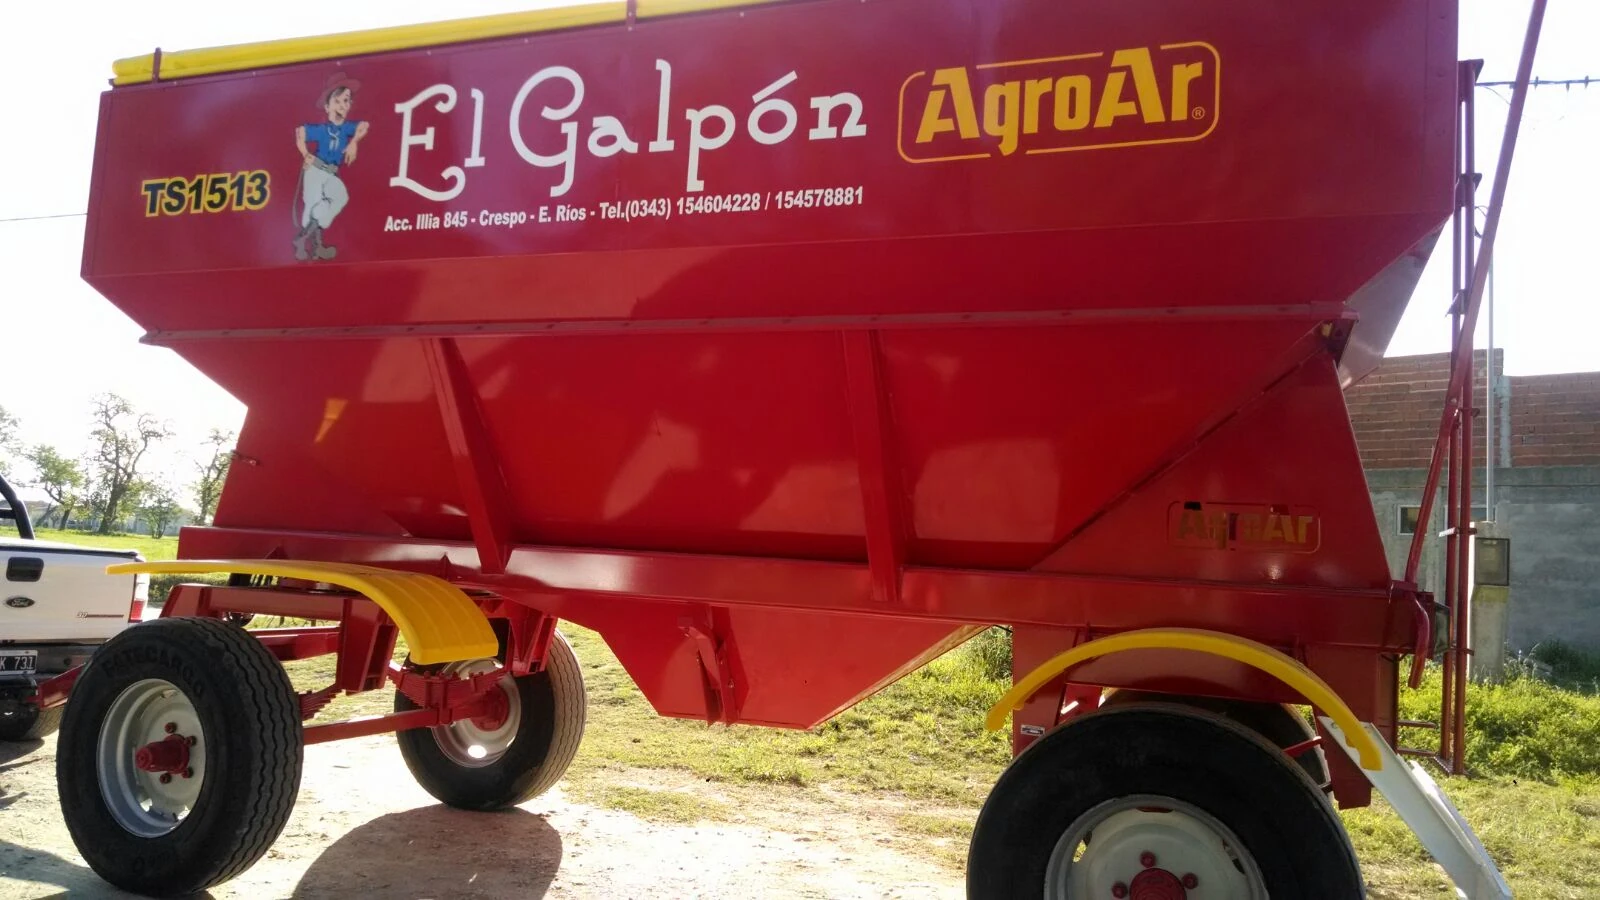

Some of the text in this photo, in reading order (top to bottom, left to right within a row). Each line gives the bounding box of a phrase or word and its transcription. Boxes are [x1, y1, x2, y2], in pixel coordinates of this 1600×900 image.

[915, 47, 1203, 156] AgroAr
[390, 59, 867, 202] El Galpón
[141, 169, 271, 217] TS1513
[384, 215, 413, 232] Acc.
[416, 213, 440, 230] Illia
[443, 211, 468, 228] 845
[479, 209, 527, 229] Crespo
[538, 206, 552, 223] E.
[556, 203, 586, 222] Ríos
[600, 197, 672, 222] Tel.(0343)
[677, 193, 761, 215] 154604228
[775, 186, 864, 209] 154578881
[14, 656, 34, 670] 731
